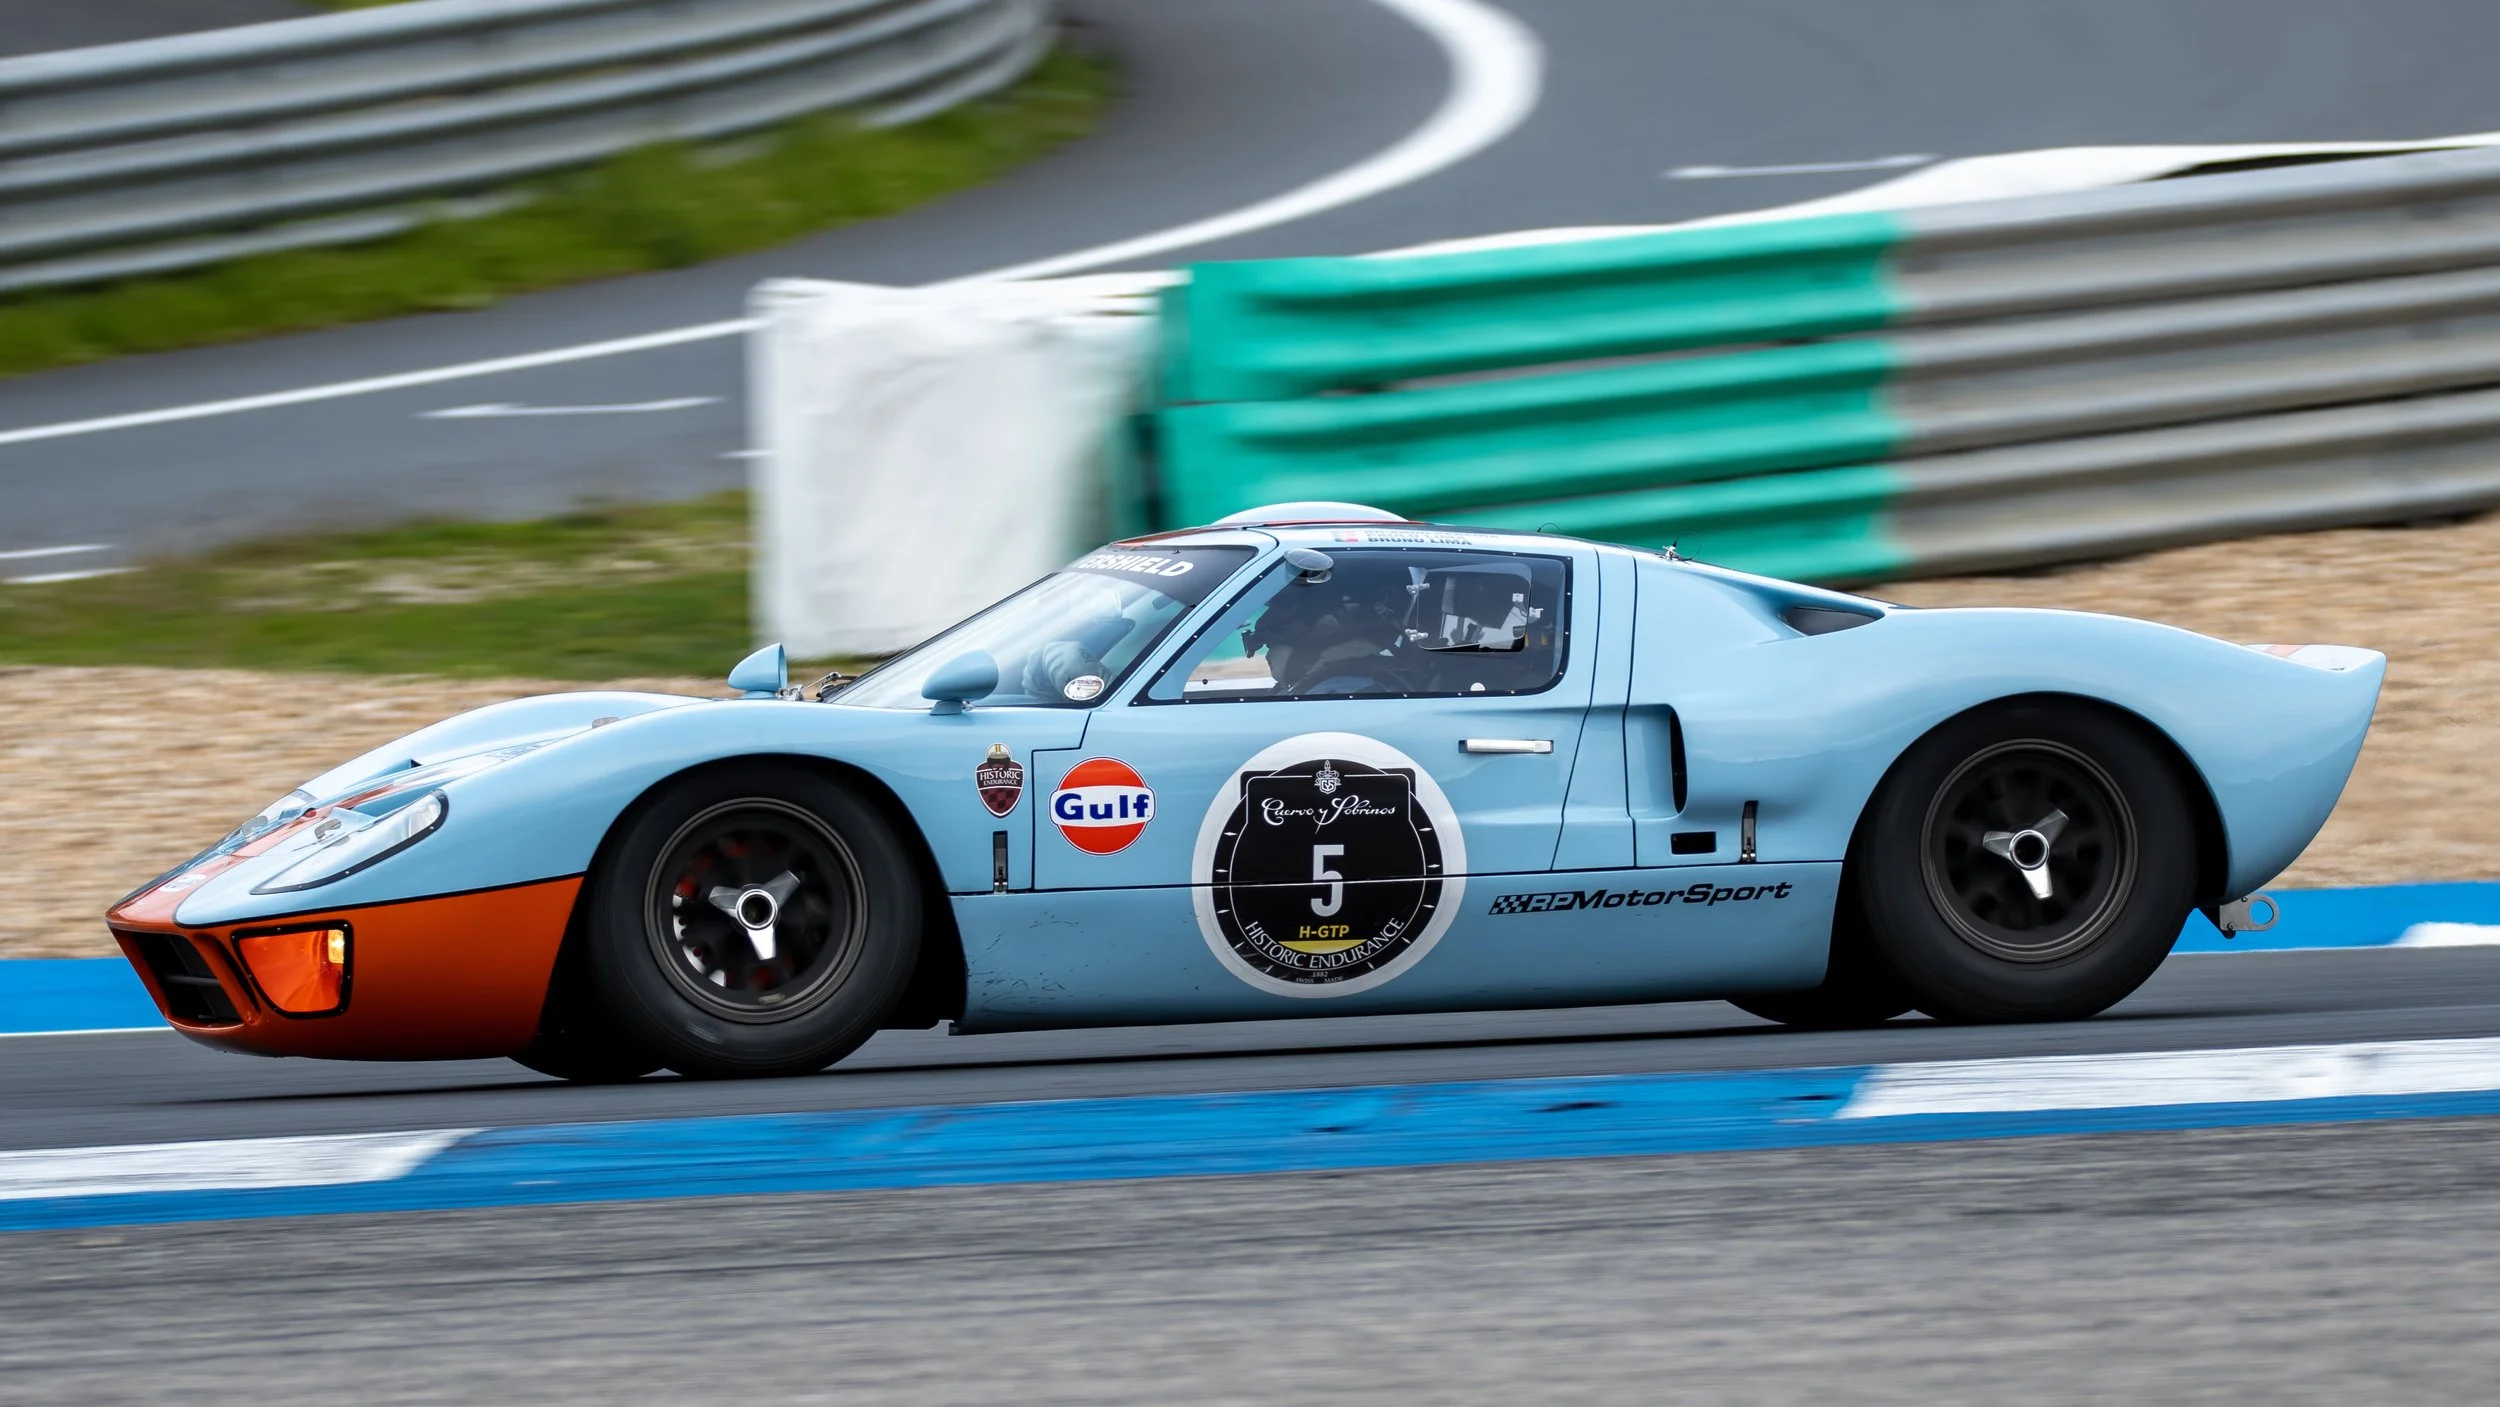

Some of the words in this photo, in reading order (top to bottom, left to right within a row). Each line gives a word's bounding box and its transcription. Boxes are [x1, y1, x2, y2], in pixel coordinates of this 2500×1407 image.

[1430, 537, 1473, 546] LIMA
[980, 770, 1021, 781] HISTORIC
[983, 779, 1018, 787] ENDURANCE
[1055, 793, 1150, 820] Gulf
[1261, 797, 1314, 826] Cuervo
[1313, 794, 1396, 826] Sobrinos
[1310, 844, 1344, 917] 5
[1299, 925, 1350, 938] H-GTP
[1245, 920, 1307, 967] HISTORIC
[1309, 917, 1405, 969] ENDURANCE
